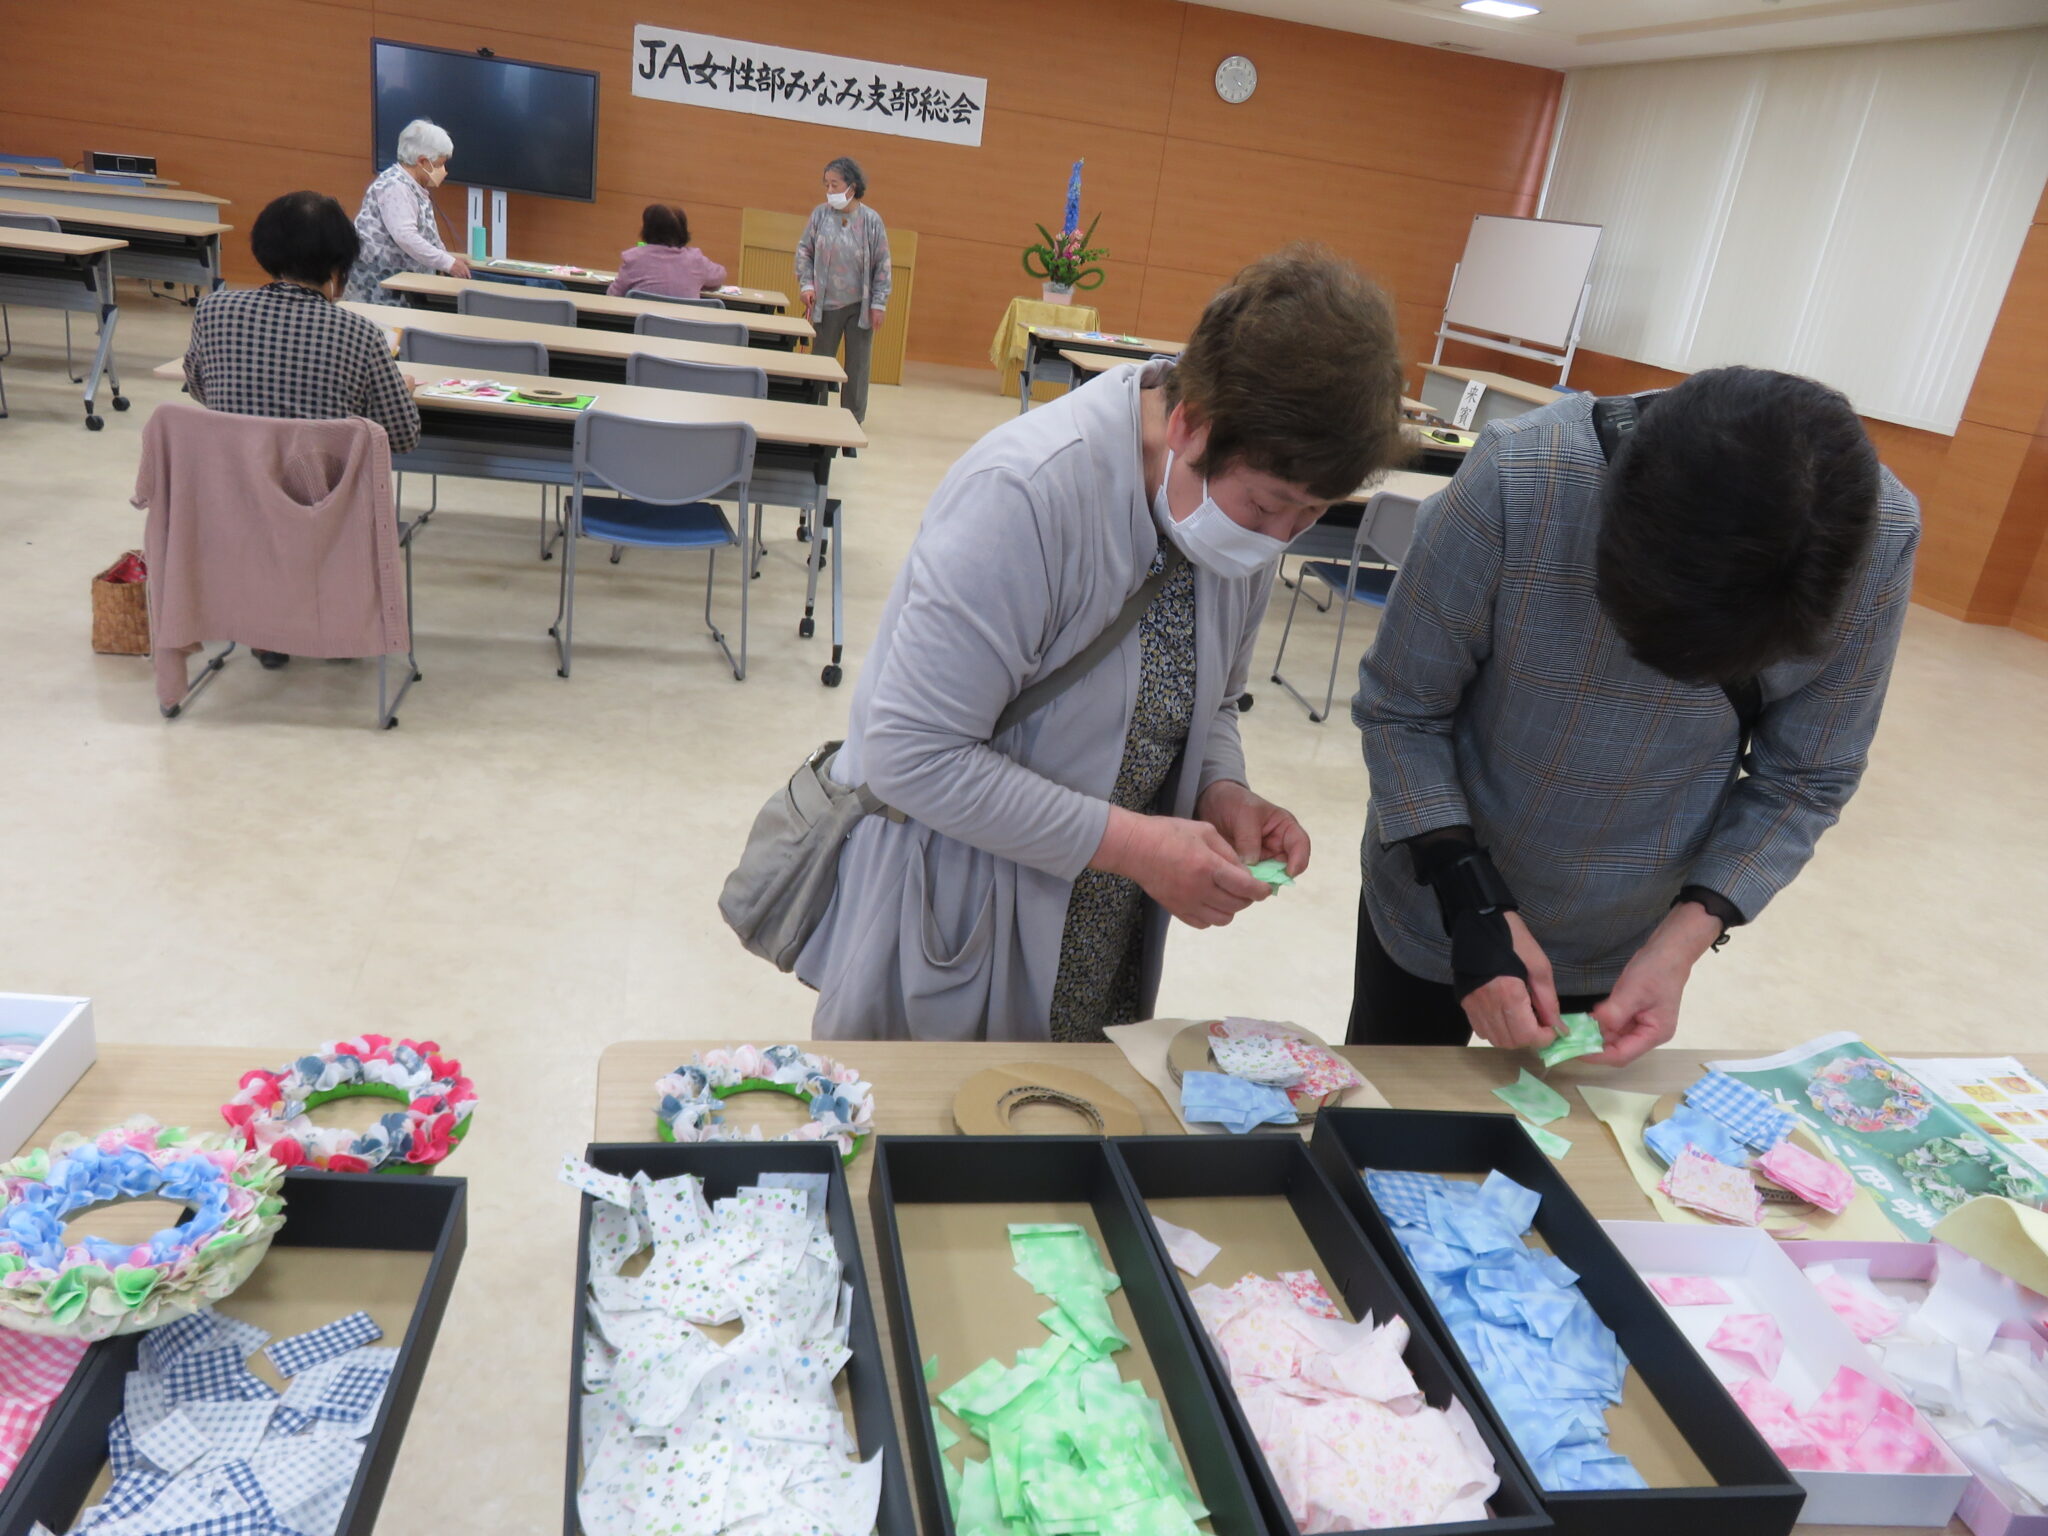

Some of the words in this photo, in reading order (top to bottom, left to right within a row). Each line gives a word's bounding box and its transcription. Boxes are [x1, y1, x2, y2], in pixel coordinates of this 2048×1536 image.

[638, 39, 981, 125] JA女性部みなみ支部総会
[1458, 387, 1479, 427] 来賓
